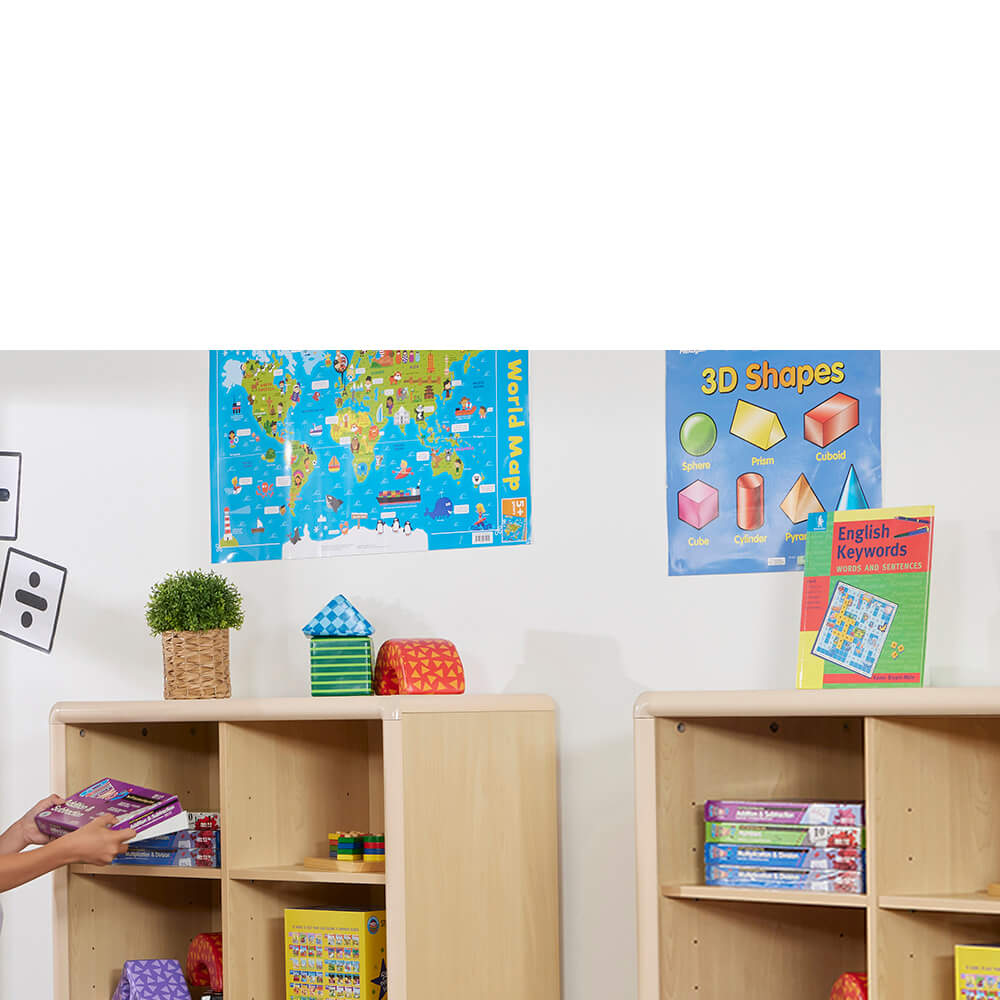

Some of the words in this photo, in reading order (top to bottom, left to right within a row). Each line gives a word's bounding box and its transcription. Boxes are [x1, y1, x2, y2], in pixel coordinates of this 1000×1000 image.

[701, 366, 739, 396] 3D
[745, 360, 846, 394] Shapes
[507, 359, 525, 428] World
[751, 456, 775, 466] Prism
[815, 450, 847, 462] Cuboid
[502, 436, 523, 491] Map
[681, 460, 711, 472] Sphere
[734, 534, 768, 545] Cylinder
[838, 525, 890, 544] English
[687, 536, 710, 546] Cube
[836, 543, 908, 562] Keywords
[836, 564, 862, 573] WORDS
[864, 563, 880, 572] AND
[882, 562, 923, 571] SENTENCES
